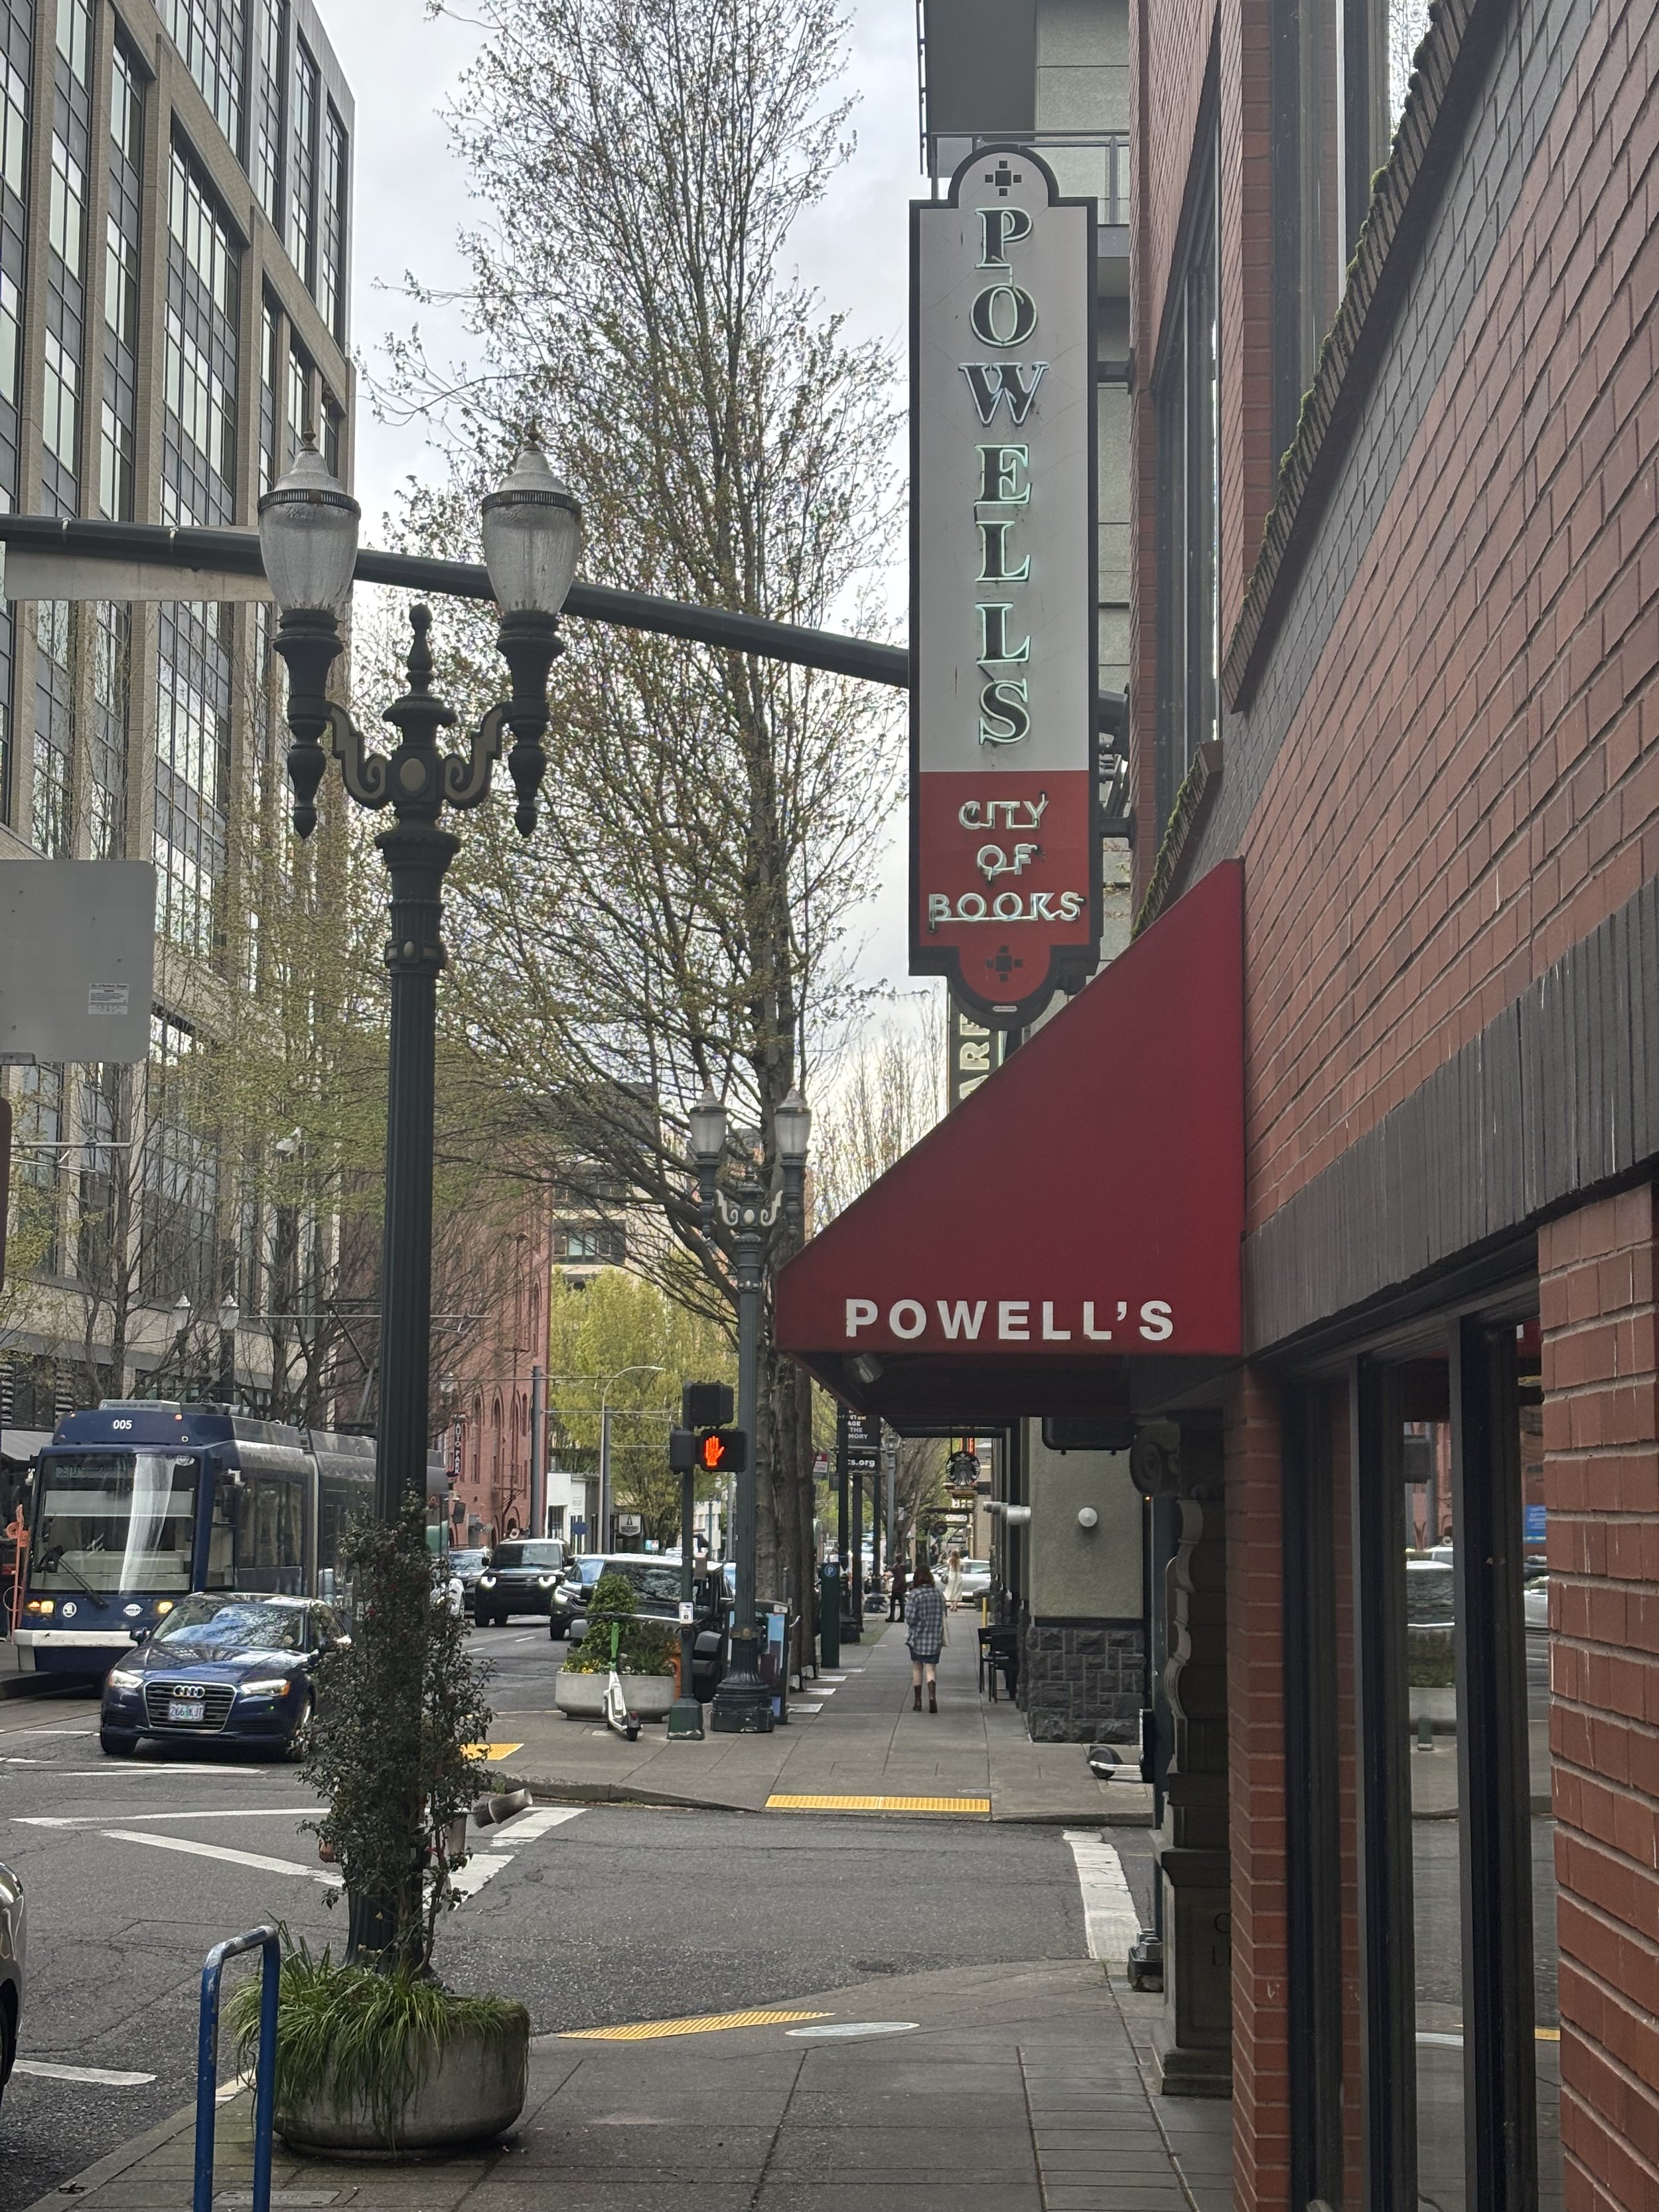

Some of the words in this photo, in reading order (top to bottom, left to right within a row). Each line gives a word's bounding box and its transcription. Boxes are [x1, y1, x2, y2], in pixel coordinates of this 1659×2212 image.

[958, 206, 1049, 745] POWELLS
[958, 798, 1049, 830] CITY
[977, 844, 1035, 876] OF
[928, 891, 1083, 922] BOOKS
[845, 1298, 1174, 1341] POWELL'S
[113, 1420, 132, 1430] 005
